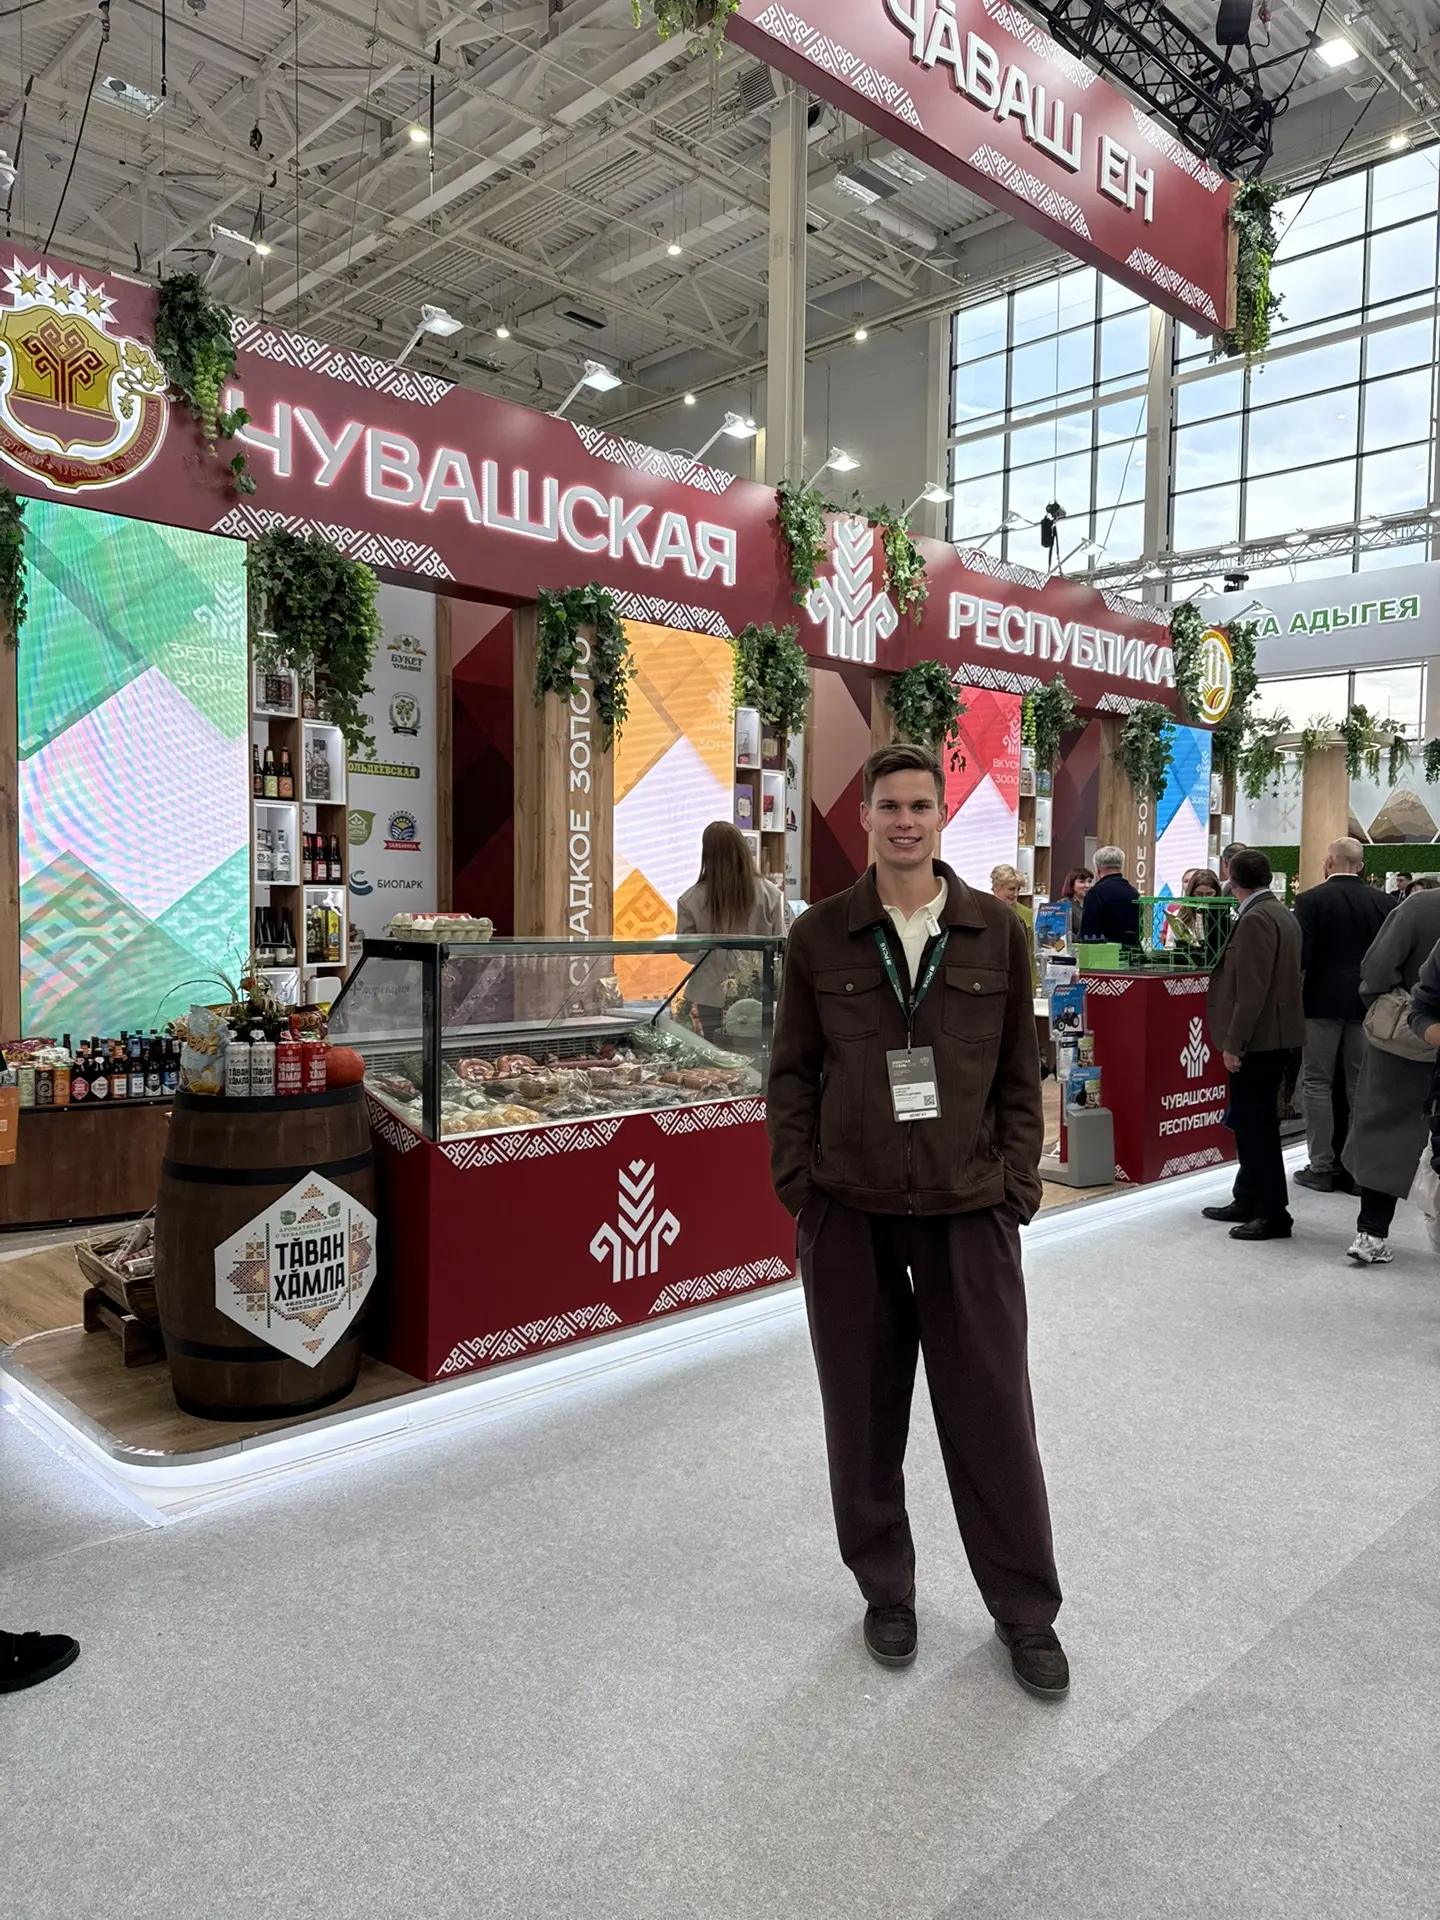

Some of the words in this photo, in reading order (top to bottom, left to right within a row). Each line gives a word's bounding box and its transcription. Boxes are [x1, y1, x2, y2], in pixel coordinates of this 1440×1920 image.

[1098, 135, 1154, 223] ЕН
[54, 459, 125, 477] ЧУВАШСКАЯ
[123, 401, 160, 466] РЕСПУБЛИКА
[225, 389, 737, 586] ЧУВАШСКАЯ
[949, 591, 1175, 687] РЕСПУБЛИКА
[1288, 595, 1420, 635] АДЫГЕЯ
[391, 653, 423, 667] БУКЕТ
[377, 879, 423, 890] БИОПАРК
[569, 810, 592, 988] САДКОЕ
[1136, 845, 1147, 897] НОЕ
[1161, 1085, 1226, 1110] ЧУВАШСКАЯ
